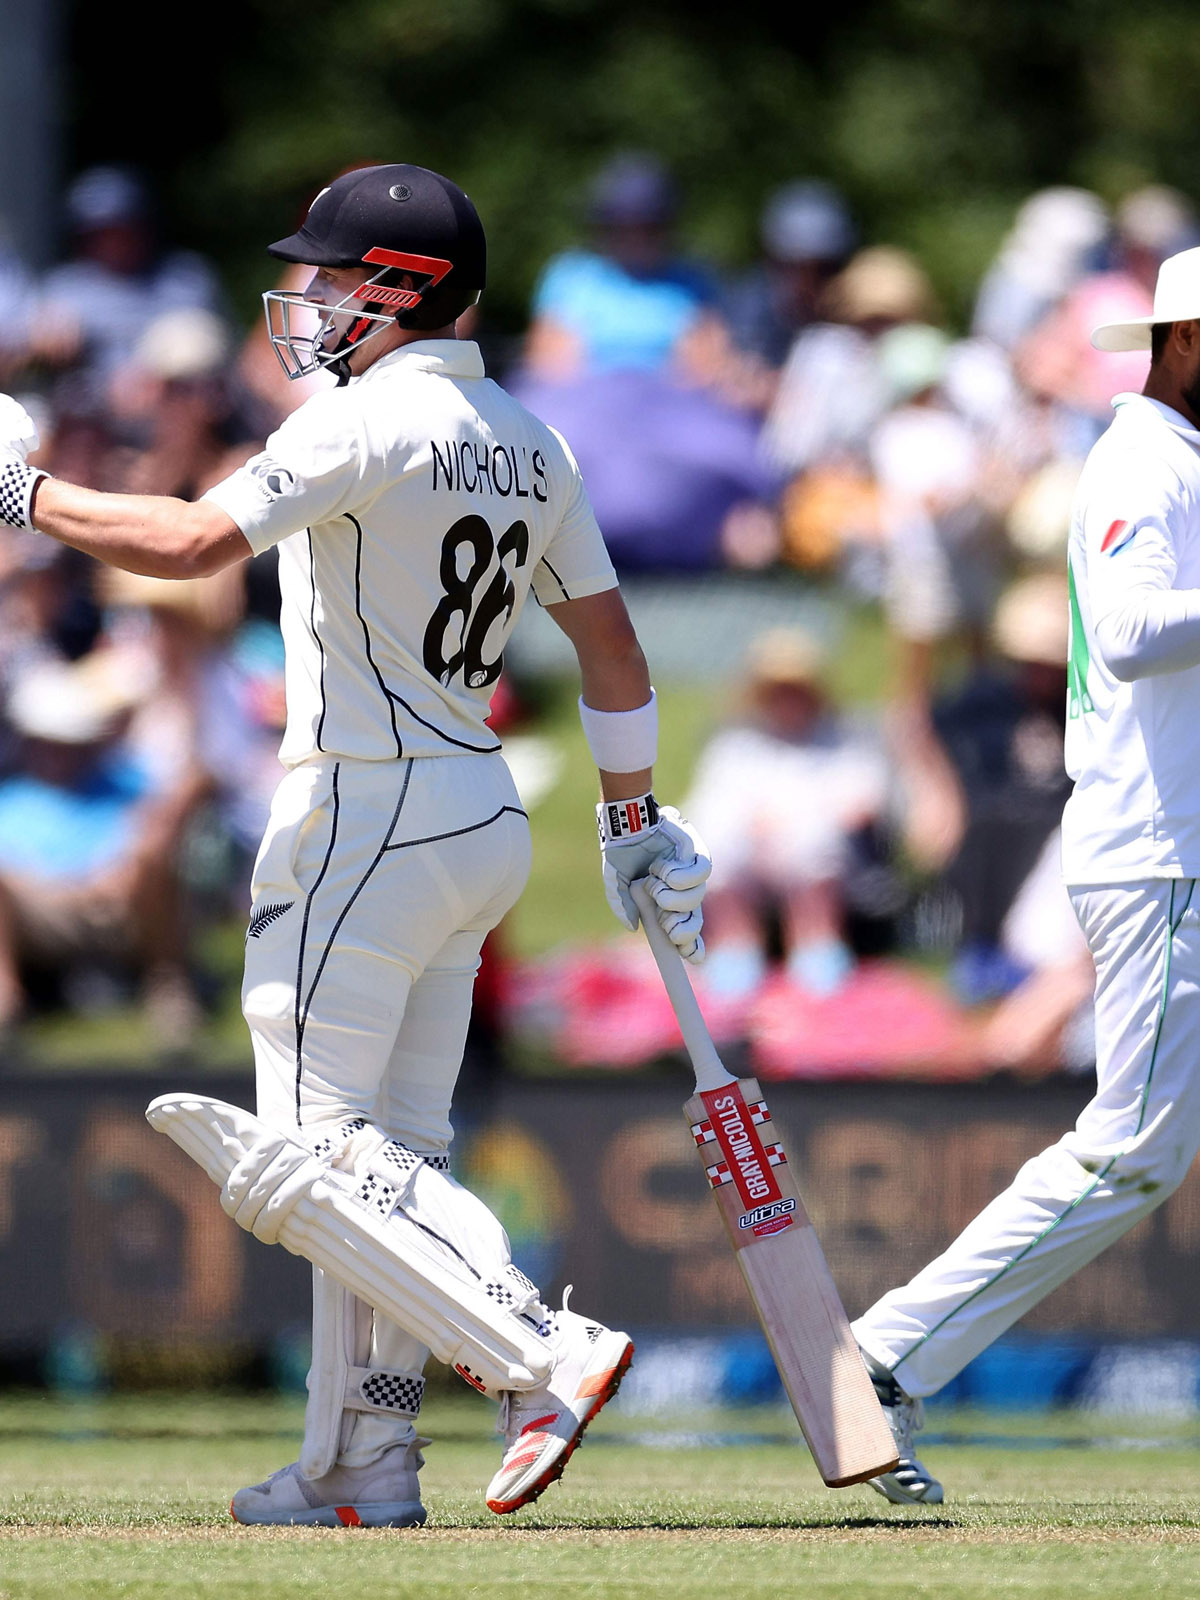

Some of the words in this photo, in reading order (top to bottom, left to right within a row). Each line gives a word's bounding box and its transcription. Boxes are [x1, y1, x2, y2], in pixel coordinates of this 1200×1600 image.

[431, 440, 548, 503] NICHOLS
[422, 514, 529, 689] 86
[740, 1199, 796, 1229] ultra
